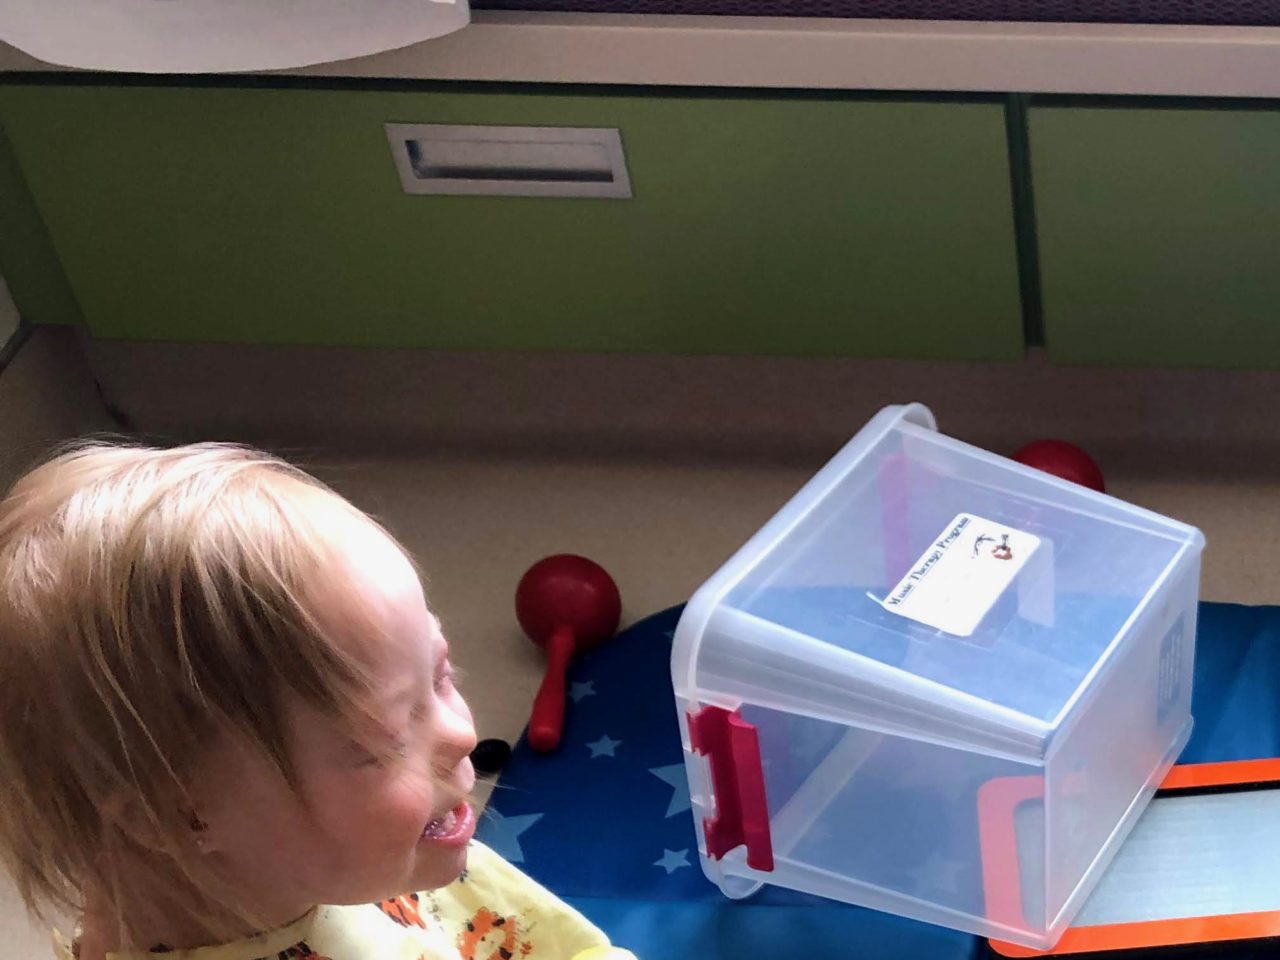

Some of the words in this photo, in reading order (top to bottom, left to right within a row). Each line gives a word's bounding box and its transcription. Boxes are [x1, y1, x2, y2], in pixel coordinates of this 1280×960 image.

[888, 583, 913, 606] Music
[909, 550, 943, 581] Therapy
[936, 517, 969, 549] Program
